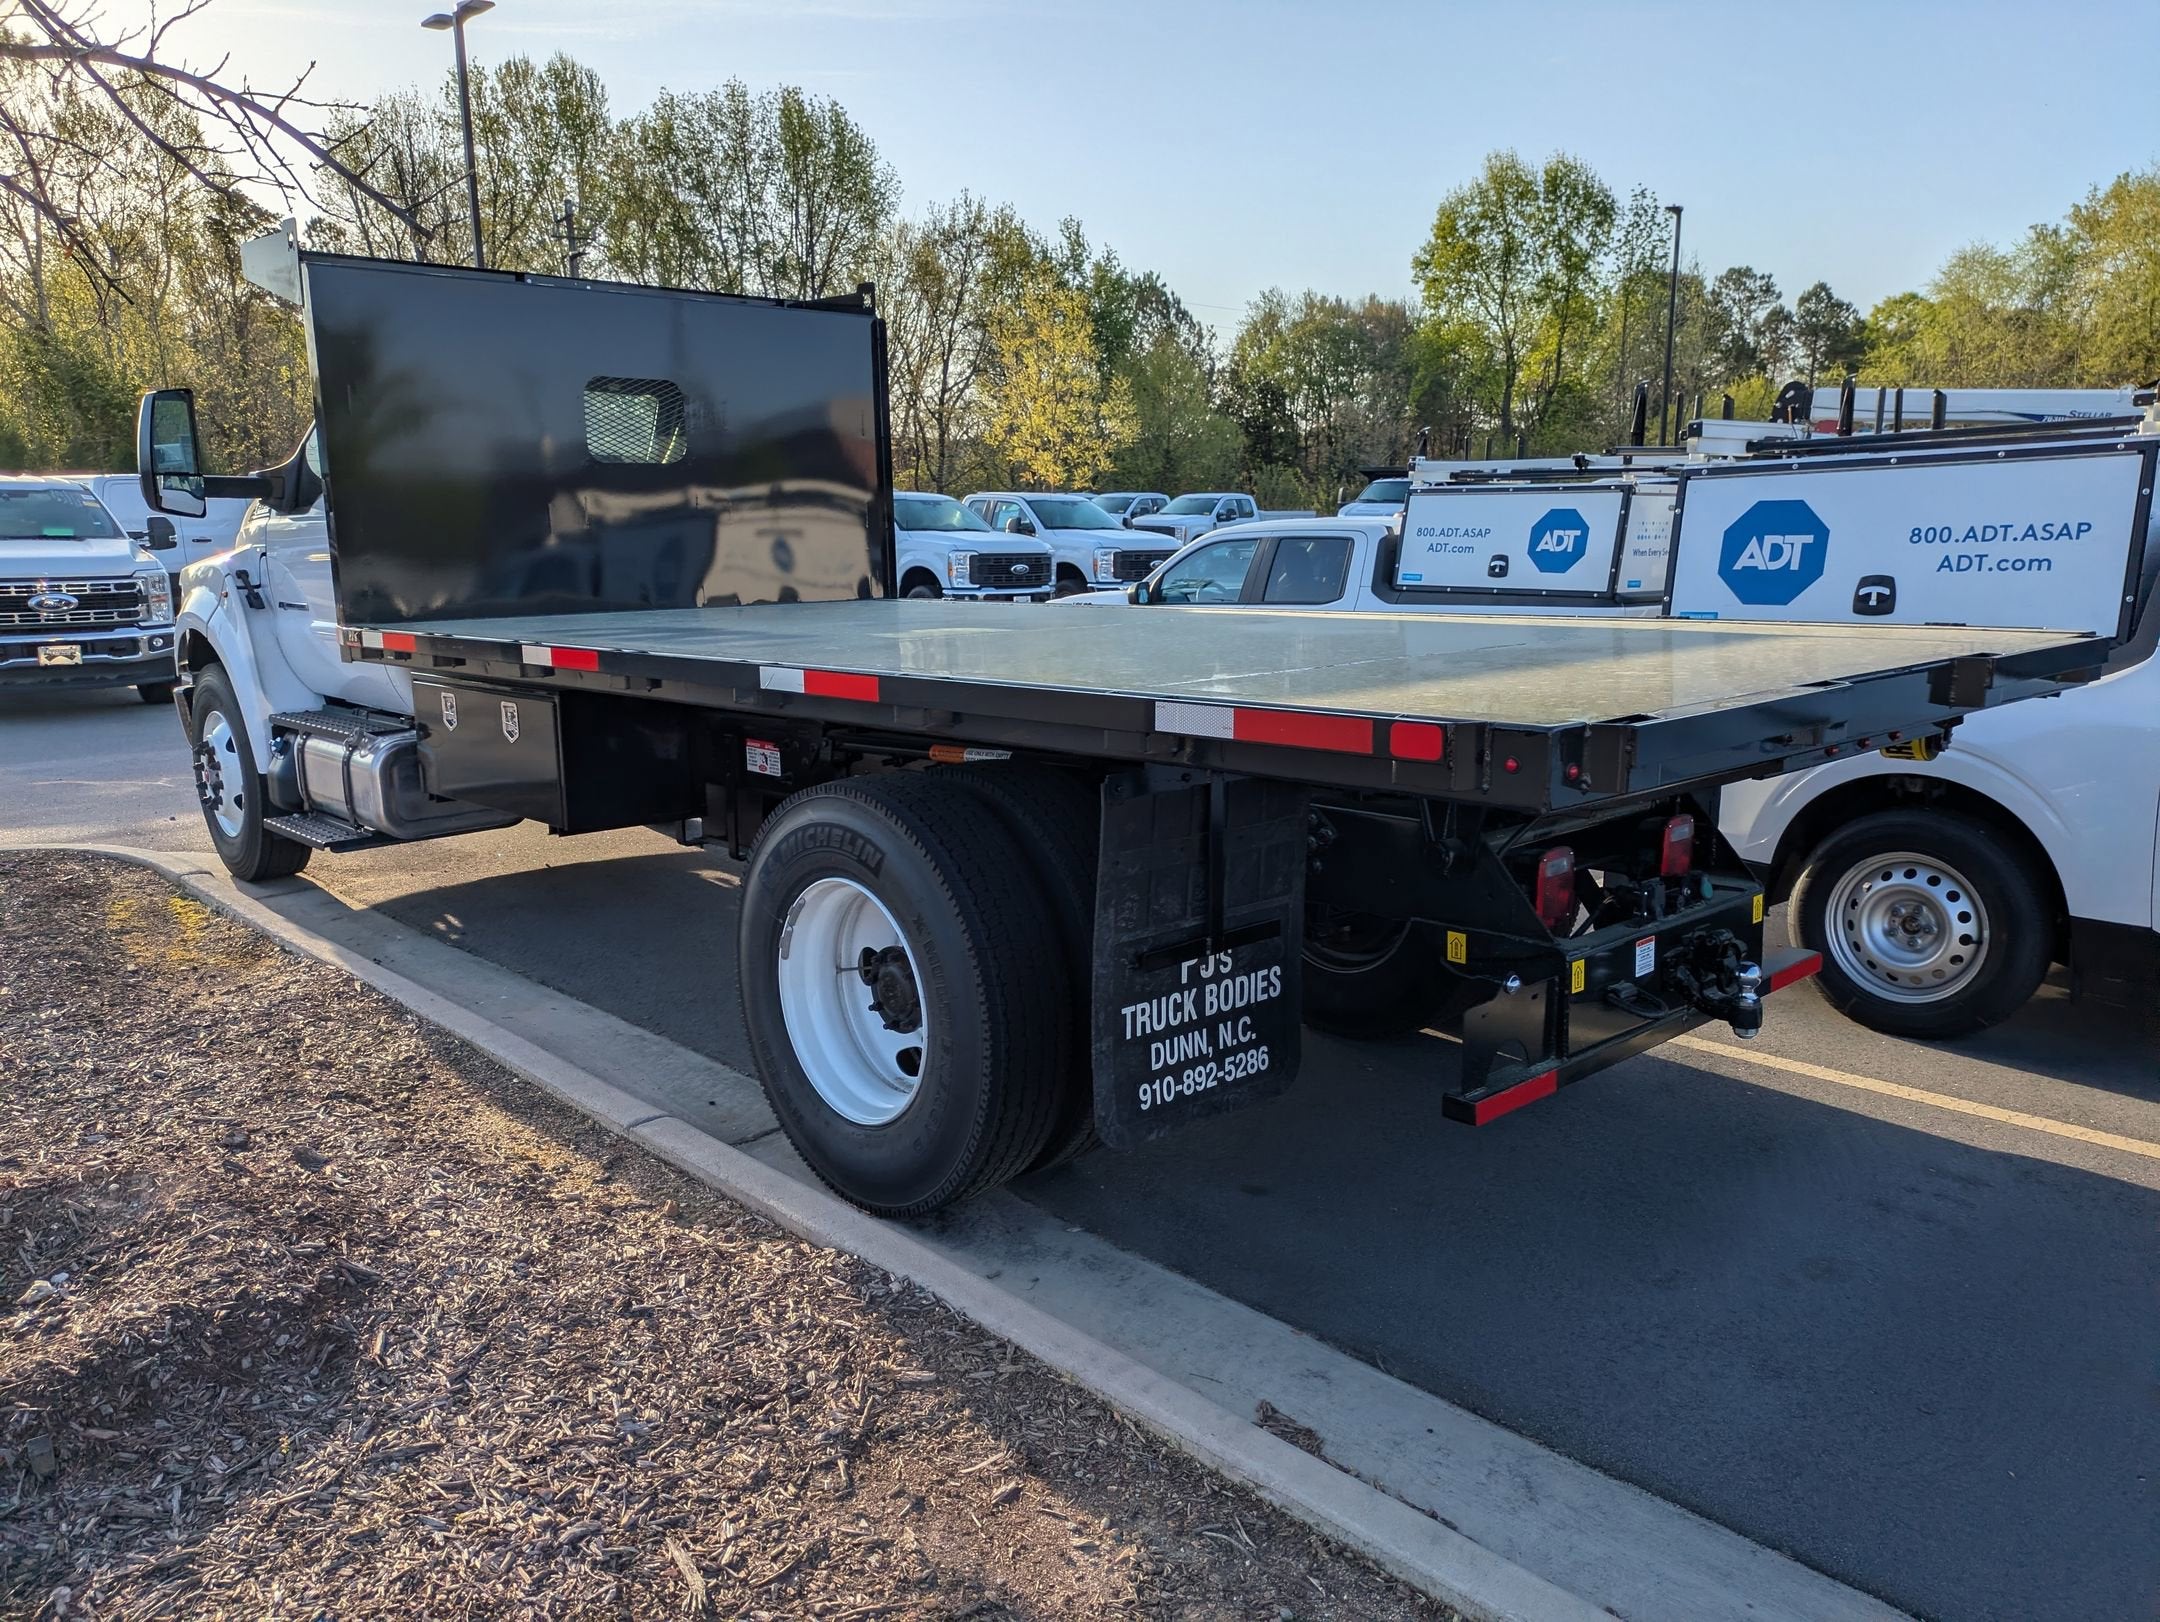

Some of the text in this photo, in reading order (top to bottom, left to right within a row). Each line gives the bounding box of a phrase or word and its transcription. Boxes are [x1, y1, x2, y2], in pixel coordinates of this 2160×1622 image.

[1416, 527, 1491, 538] 800.ADT.ASAP
[1535, 530, 1581, 553] ADT
[1908, 522, 2092, 544] 800.ADT.ASAP
[1427, 543, 1475, 554] ADT.com
[1632, 548, 1647, 557] When
[1648, 548, 1661, 559] Every
[1732, 535, 1814, 570] ADT
[1936, 554, 2052, 573] ADT.com
[780, 825, 884, 869] MICHELIN
[1121, 965, 1281, 1040] TRUCK BODIES
[1151, 1016, 1257, 1071] DUNN, N.C.
[1138, 1045, 1269, 1111] 910-892-5286
